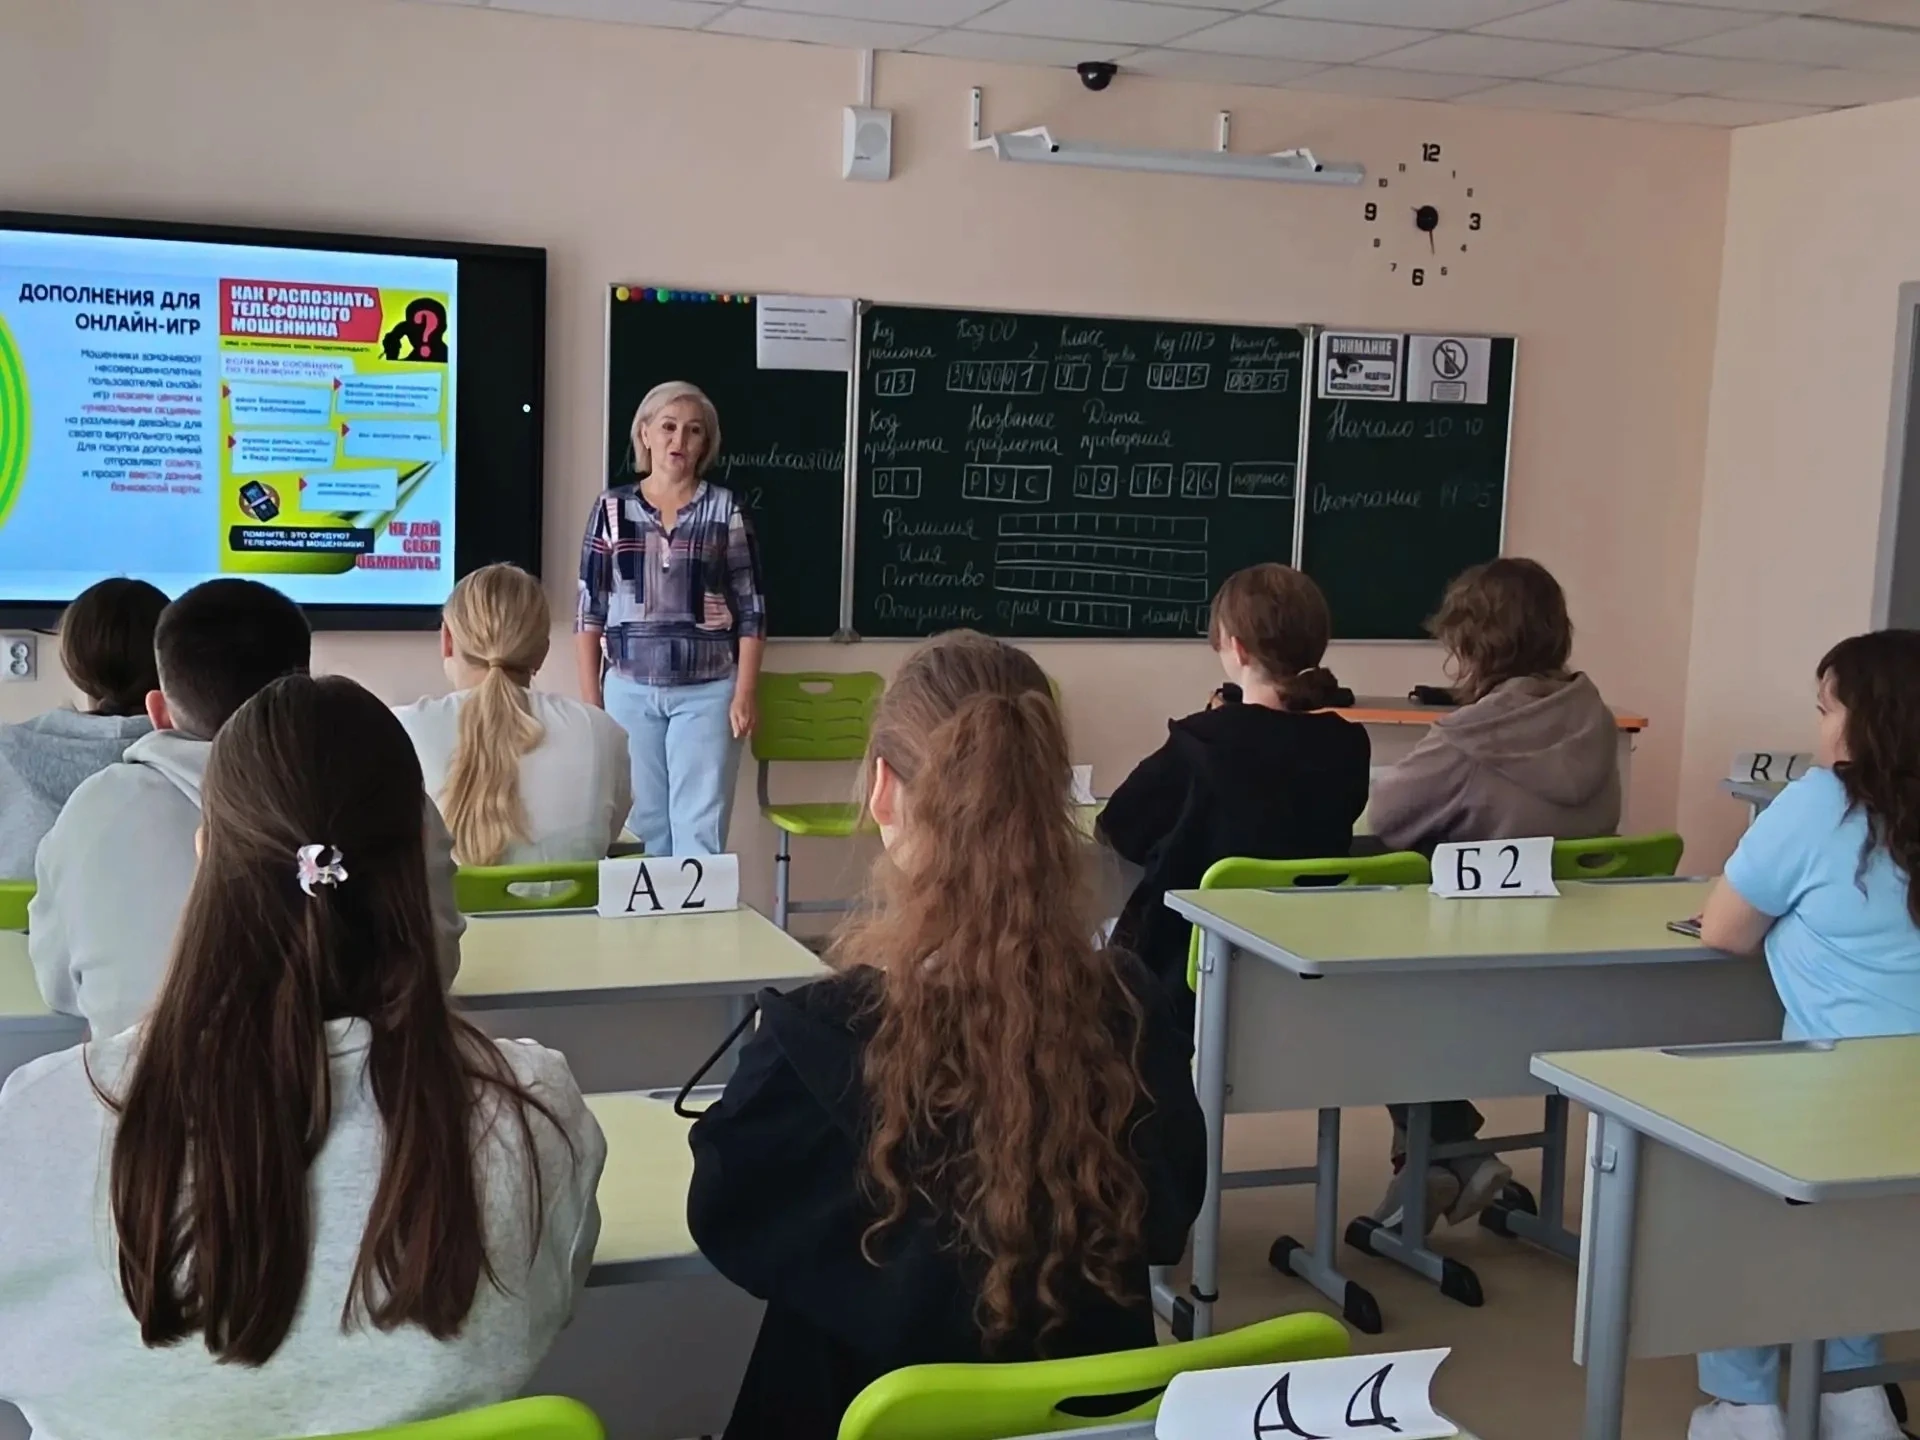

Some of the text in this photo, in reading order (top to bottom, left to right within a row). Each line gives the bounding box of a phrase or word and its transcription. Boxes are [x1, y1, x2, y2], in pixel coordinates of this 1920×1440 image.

[1422, 143, 1441, 162] 12
[1364, 202, 1378, 221] 9
[1469, 212, 1482, 231] 3
[1390, 262, 1398, 272] 7
[1412, 268, 1425, 286] 6
[19, 282, 201, 310] ДОПОЛНЕНИЯ ДЛЯ
[231, 285, 375, 308] КАК РАСПОЗНАТЬ
[231, 301, 351, 322] ТЕЛЕФОННОГО
[75, 311, 201, 335] ОНЛАЙН-ИГР
[231, 317, 338, 338] МОШЕННИКА
[1332, 338, 1392, 355] ВНИМАНИЕ
[1083, 398, 1144, 425] Дата
[1326, 401, 1414, 442] Начало
[389, 520, 441, 537] НЕ ДАЙ
[403, 539, 441, 554] СЕБЯ
[355, 554, 441, 572] ОБМАНУТЬ!
[1456, 845, 1521, 891] Б 2
[625, 858, 706, 912] А 2
